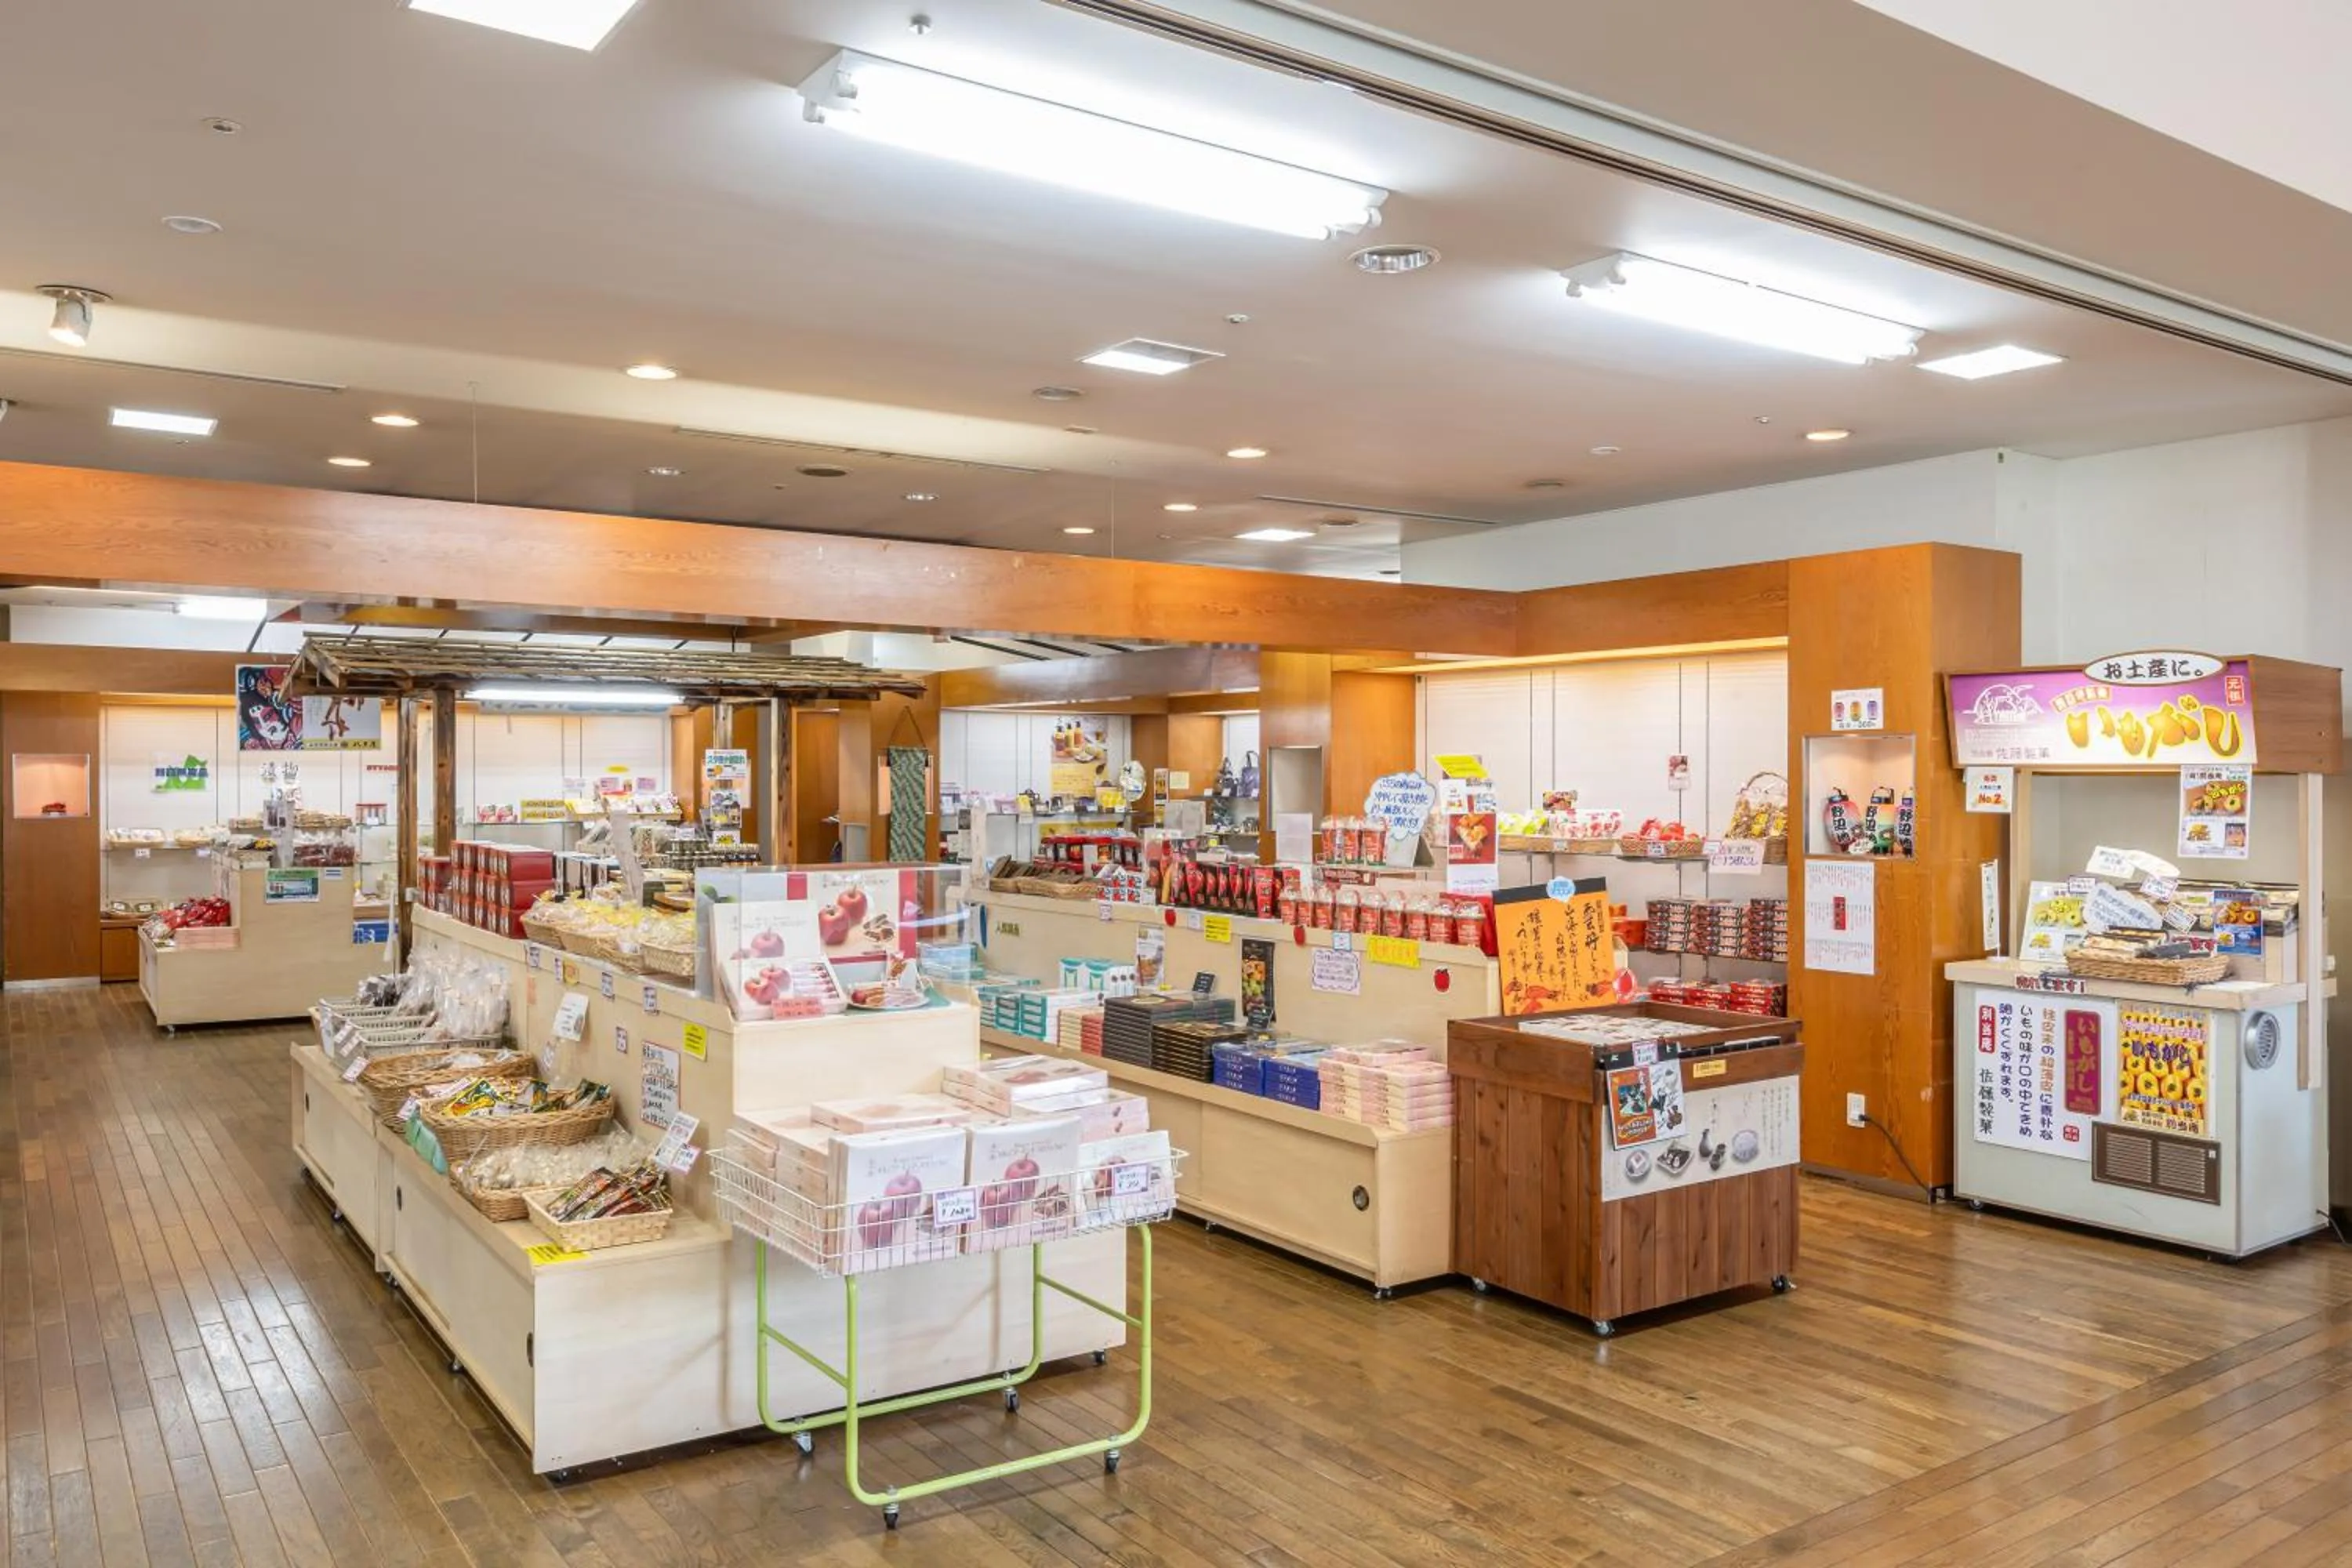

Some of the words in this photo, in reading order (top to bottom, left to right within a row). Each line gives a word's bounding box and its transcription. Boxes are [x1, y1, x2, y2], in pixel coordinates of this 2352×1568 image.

[2104, 659, 2204, 681] お土産に。
[2065, 695, 2242, 759] いもがし
[2019, 1004, 2033, 1137] いもの味が口の中できめ
[2076, 1017, 2096, 1093] いもがし
